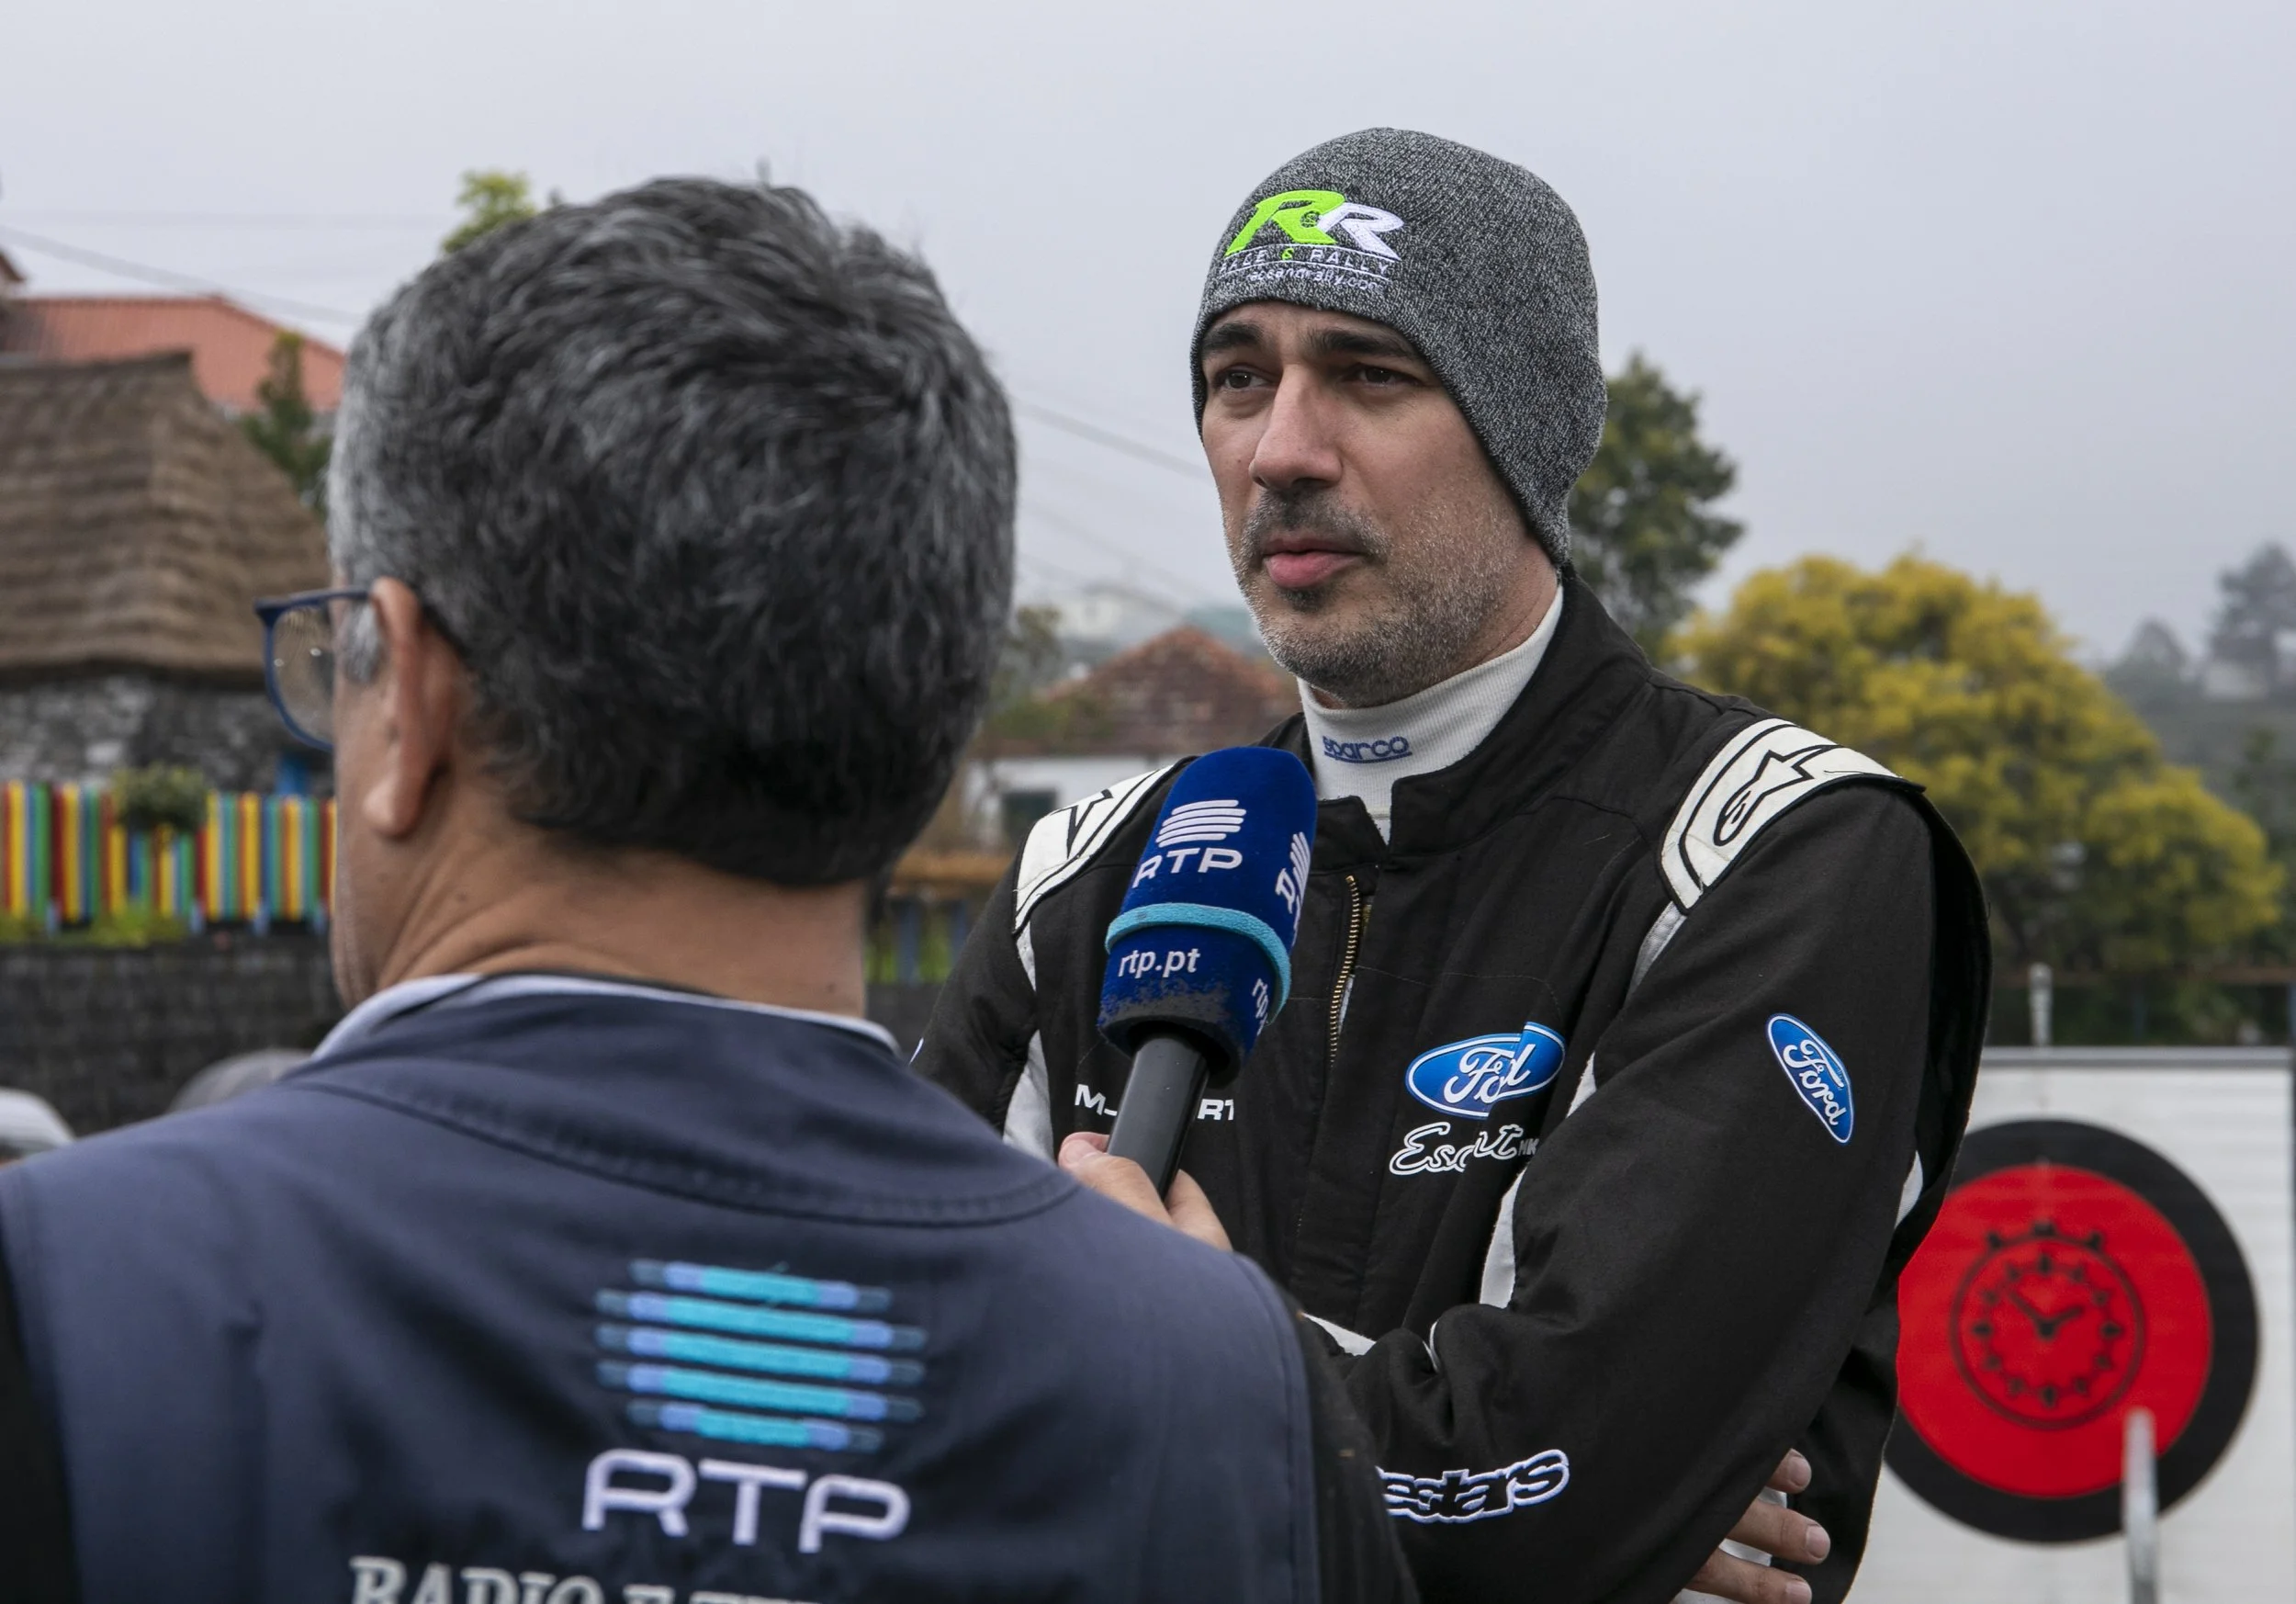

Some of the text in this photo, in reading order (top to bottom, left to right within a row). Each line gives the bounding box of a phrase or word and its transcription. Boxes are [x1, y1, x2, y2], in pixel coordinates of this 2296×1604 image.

[1219, 249, 1269, 275] RACE
[1309, 248, 1390, 276] RALLY
[1322, 735, 1410, 760] sparco
[1132, 847, 1244, 888] RTP
[1118, 947, 1201, 979] rtp.pt
[1783, 1039, 1847, 1125] Ford
[582, 1448, 911, 1553] RTP
